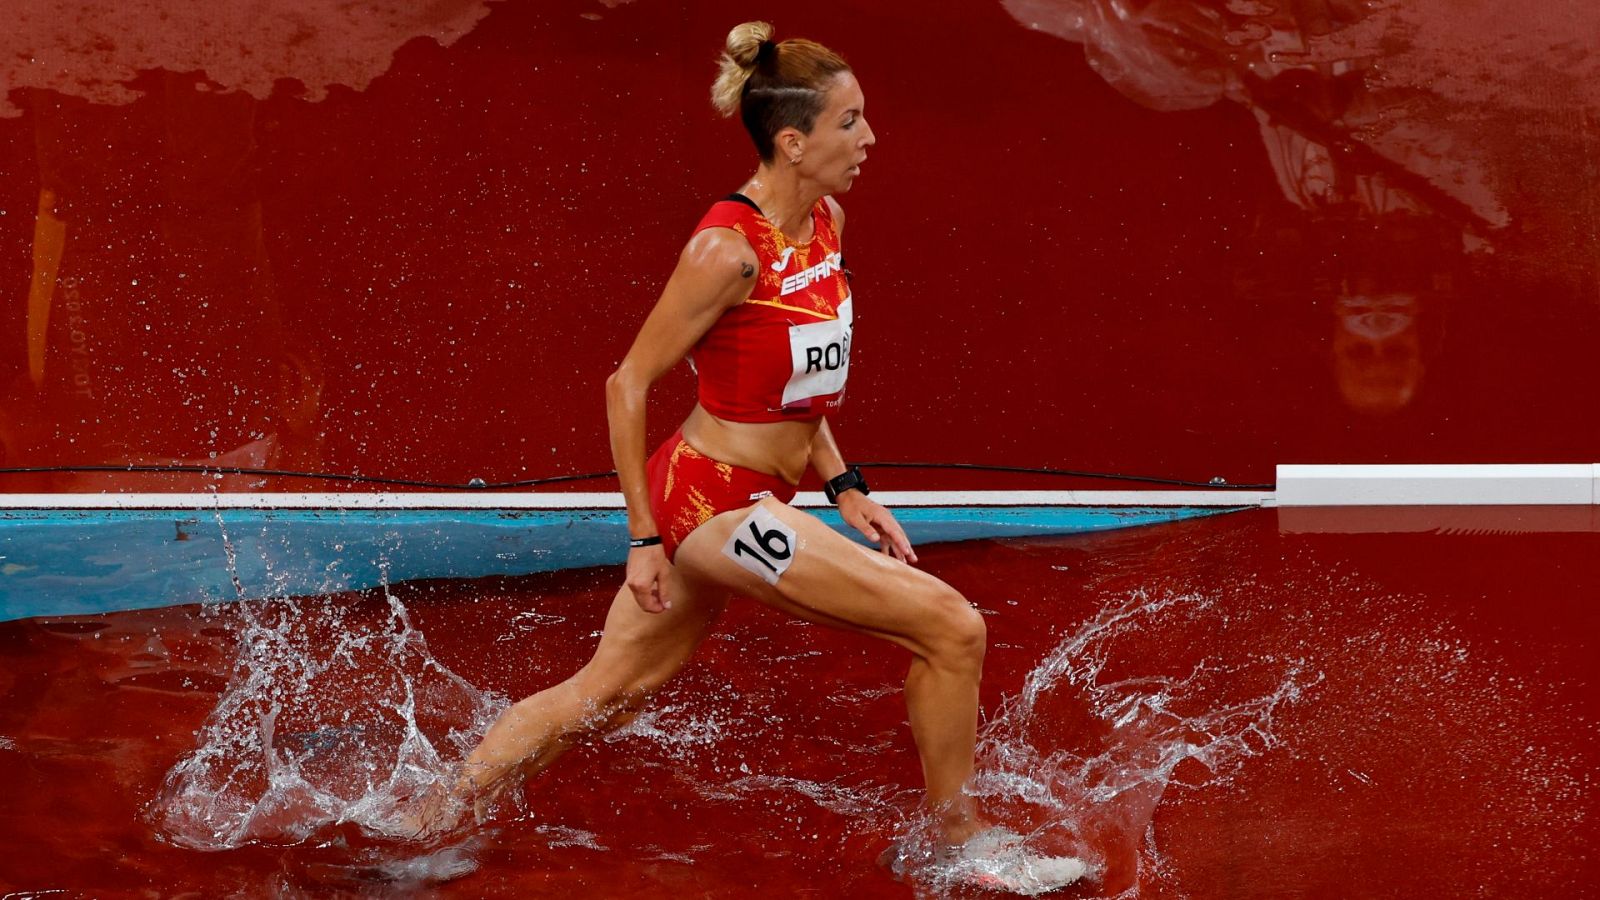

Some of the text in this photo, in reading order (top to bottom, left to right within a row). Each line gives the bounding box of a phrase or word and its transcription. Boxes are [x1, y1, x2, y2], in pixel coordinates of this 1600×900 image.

[780, 252, 841, 296] ESPAÑ
[805, 334, 850, 375] ROB
[734, 520, 791, 573] 16
